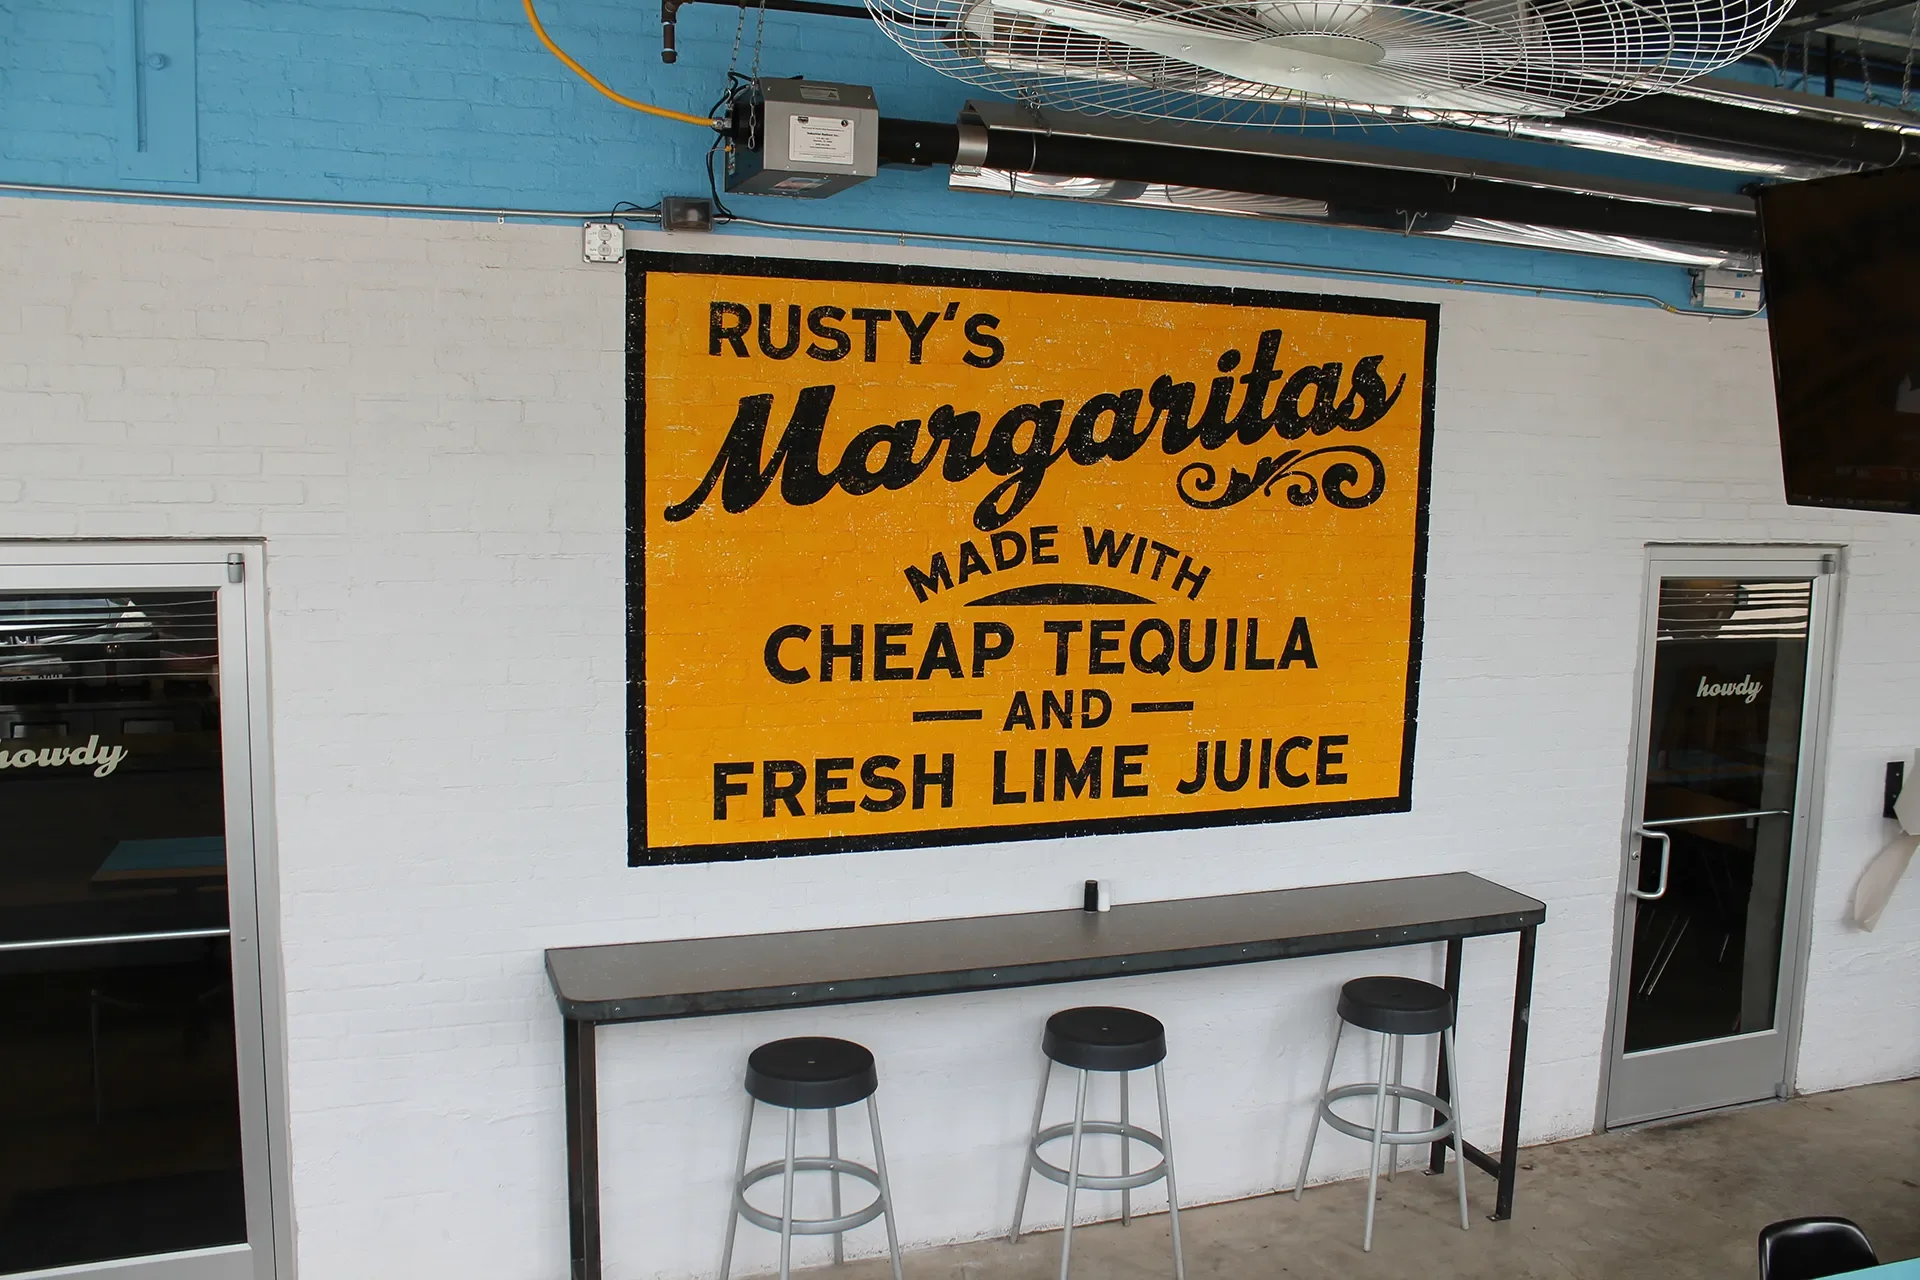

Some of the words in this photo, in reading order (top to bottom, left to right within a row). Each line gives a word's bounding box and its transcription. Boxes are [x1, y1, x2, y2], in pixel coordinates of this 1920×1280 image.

[708, 301, 1005, 368] RUSTY'S
[664, 329, 1406, 531] Margaritas
[904, 525, 1059, 603] MADE
[1082, 526, 1211, 600] WITH
[764, 622, 1015, 684] CHEAP
[1044, 616, 1318, 676] TEQUILA
[1002, 689, 1112, 731] AND
[1696, 674, 1763, 704] howdy
[713, 753, 955, 820] FRESH
[992, 744, 1149, 805] LIME
[1175, 735, 1349, 794] JUICE
